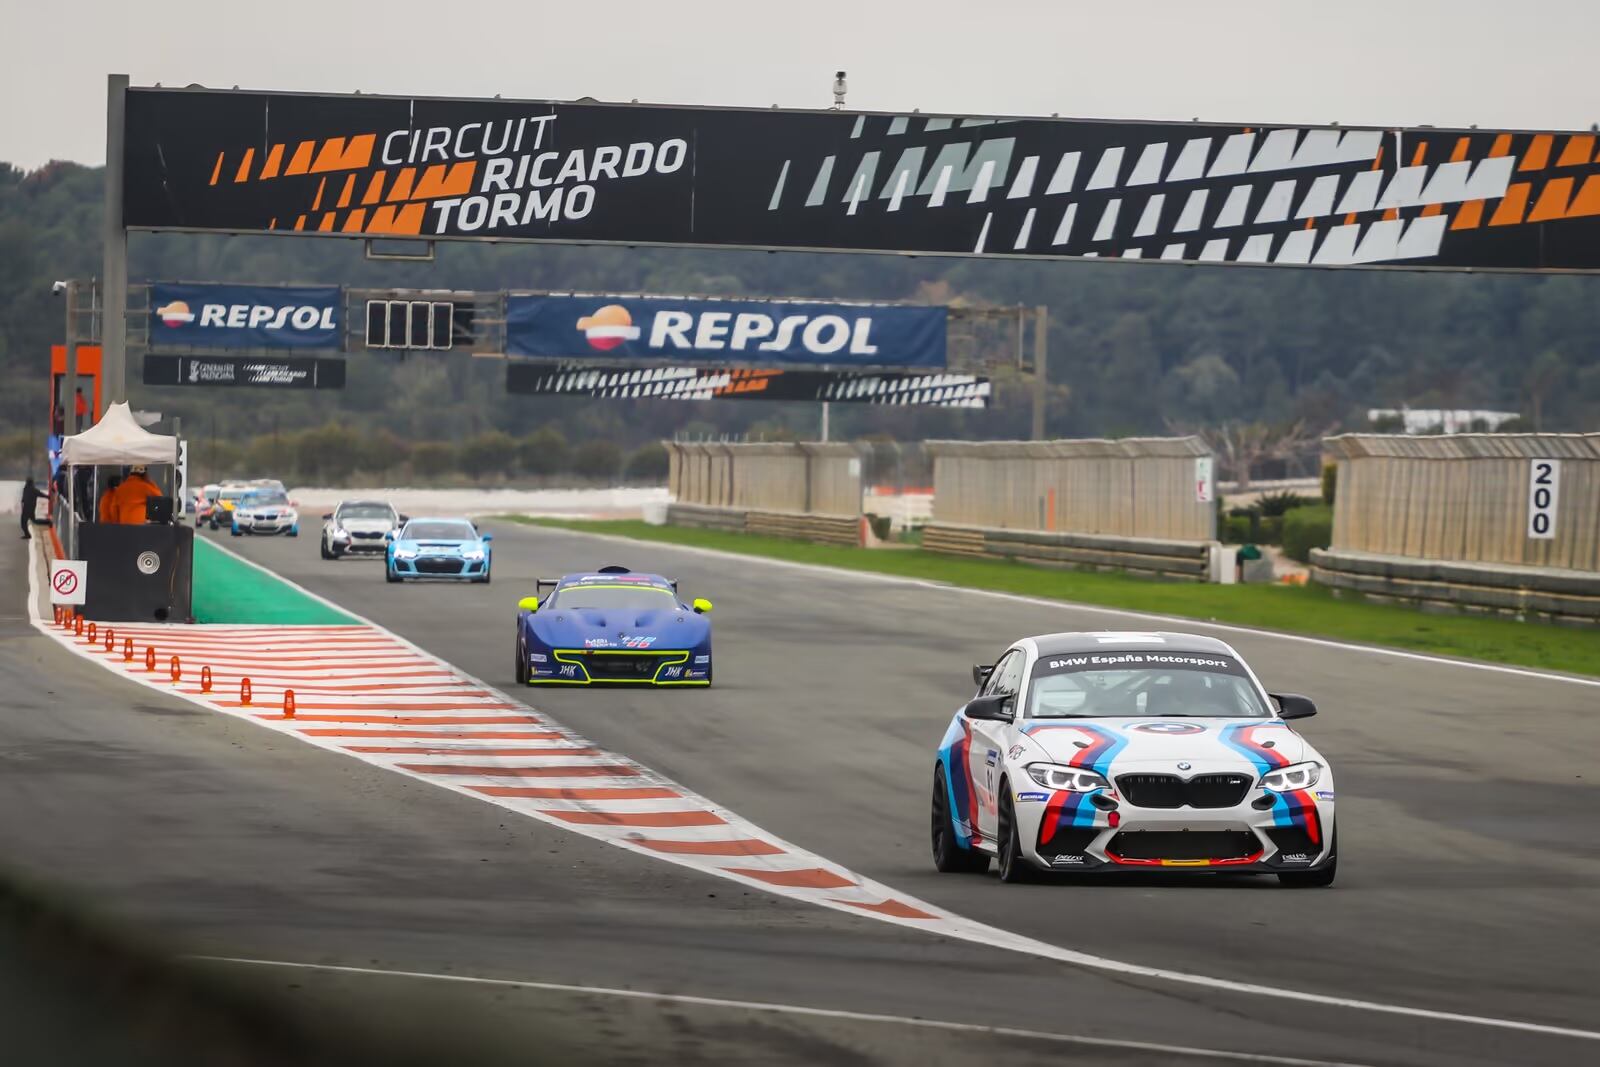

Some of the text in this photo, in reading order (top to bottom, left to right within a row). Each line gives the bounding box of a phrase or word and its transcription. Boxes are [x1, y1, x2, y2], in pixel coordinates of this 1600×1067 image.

[382, 114, 557, 165] CIRCUIT
[480, 138, 687, 193] RICARDO
[432, 184, 596, 234] TORMO
[200, 304, 336, 330] REPSOL
[649, 310, 878, 354] REPSOL
[1533, 463, 1552, 534] 200
[1050, 654, 1228, 669] BMW España Motorsport
